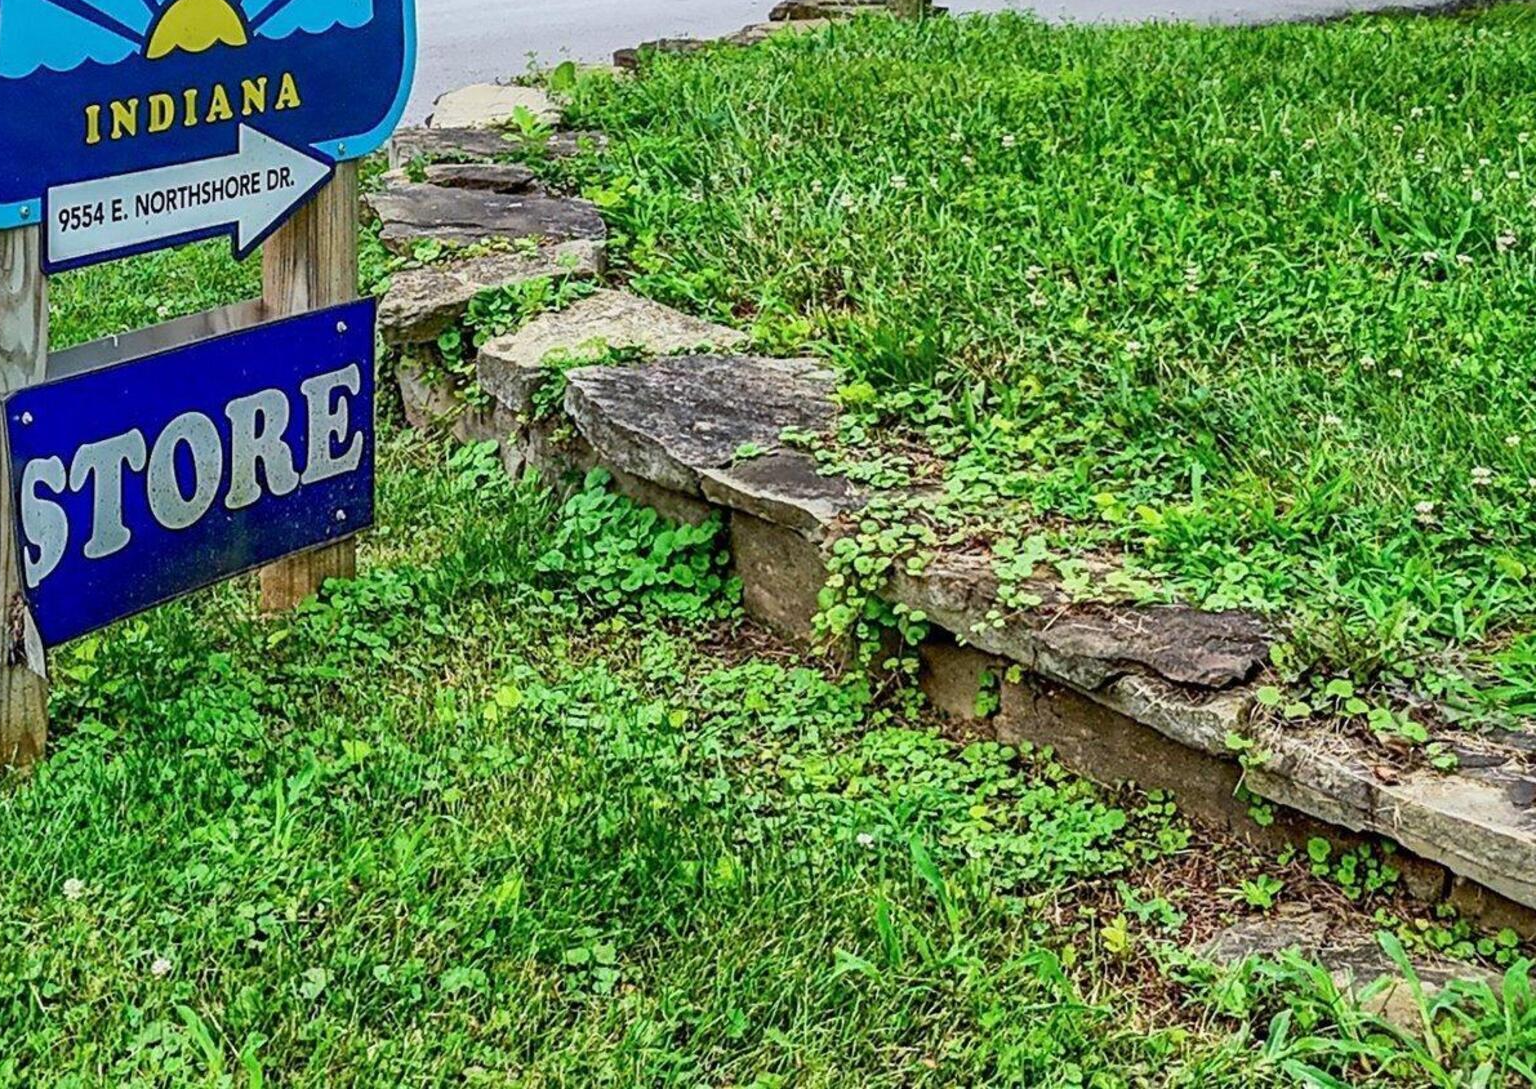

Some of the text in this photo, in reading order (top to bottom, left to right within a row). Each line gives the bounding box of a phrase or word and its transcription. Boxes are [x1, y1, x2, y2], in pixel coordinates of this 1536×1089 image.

[85, 72, 301, 144] INDIANA
[59, 166, 295, 232] 9554 E. NORTHSHORE DR.
[20, 363, 364, 589] STORE
